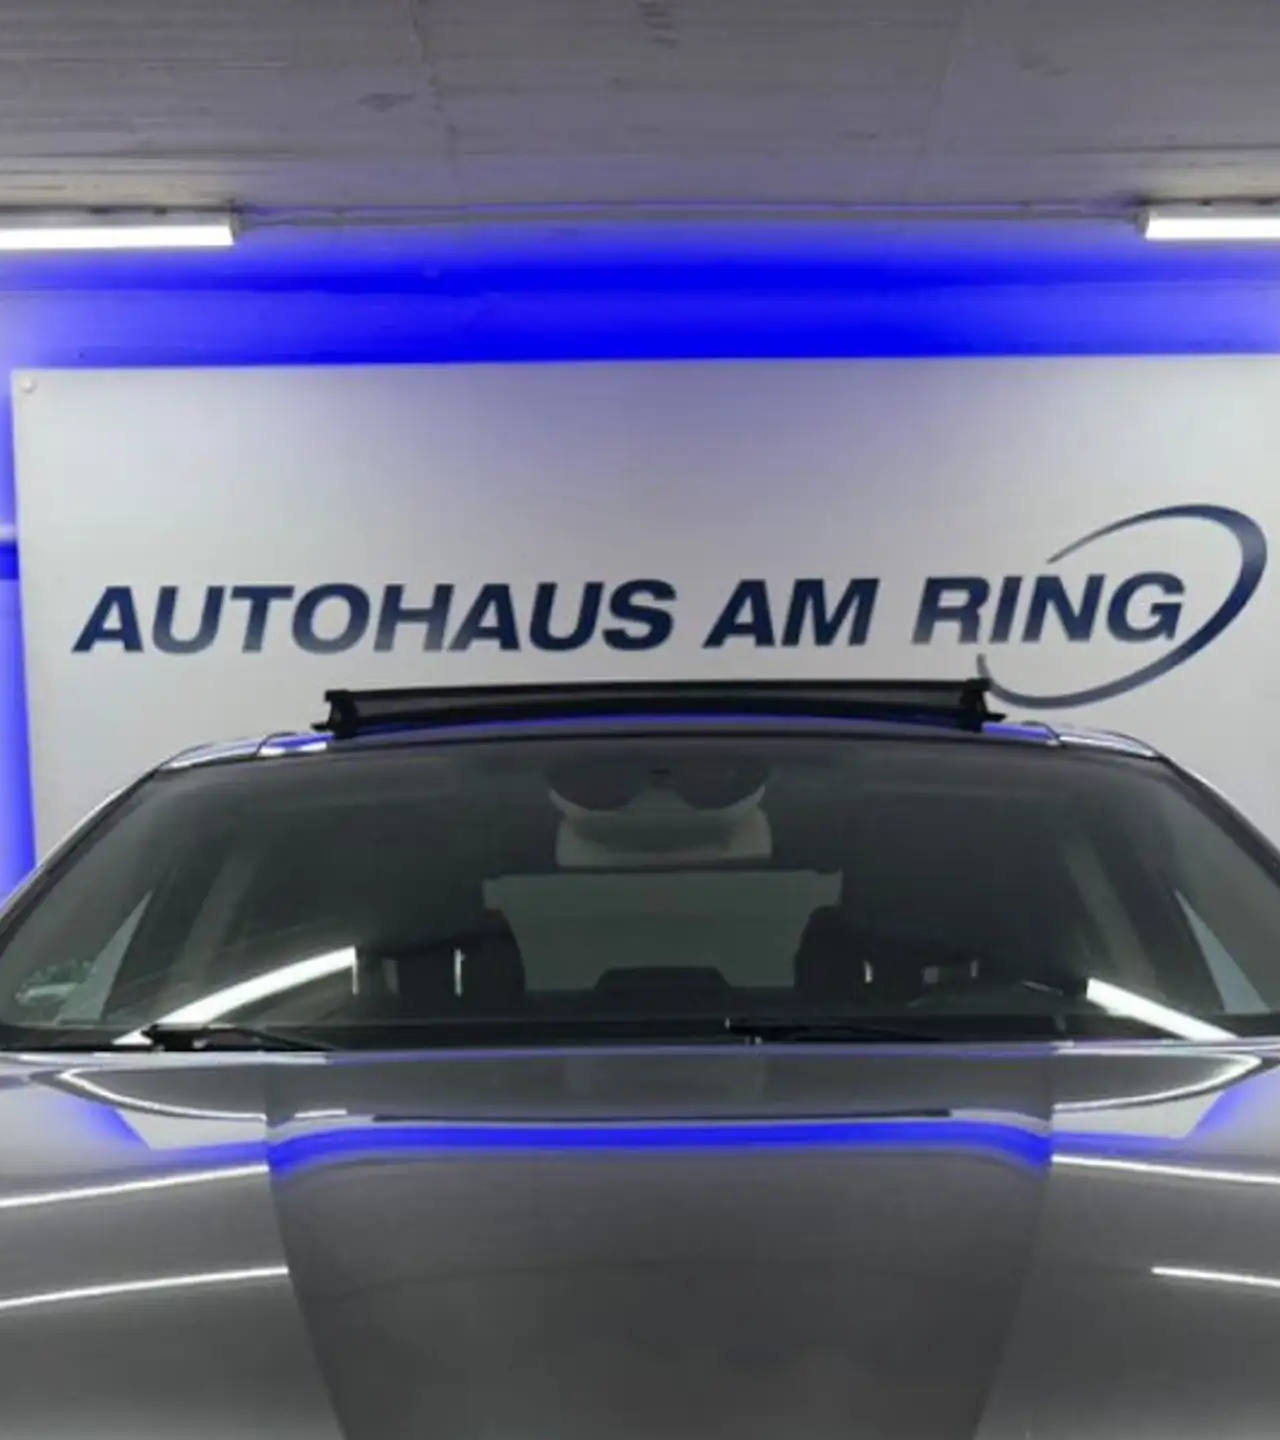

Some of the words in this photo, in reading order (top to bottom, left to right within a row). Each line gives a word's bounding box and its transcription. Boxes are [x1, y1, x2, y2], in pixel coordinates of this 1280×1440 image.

[73, 578, 675, 654] AUTOHAUS
[703, 577, 879, 650] AM
[912, 570, 1185, 646] RING
